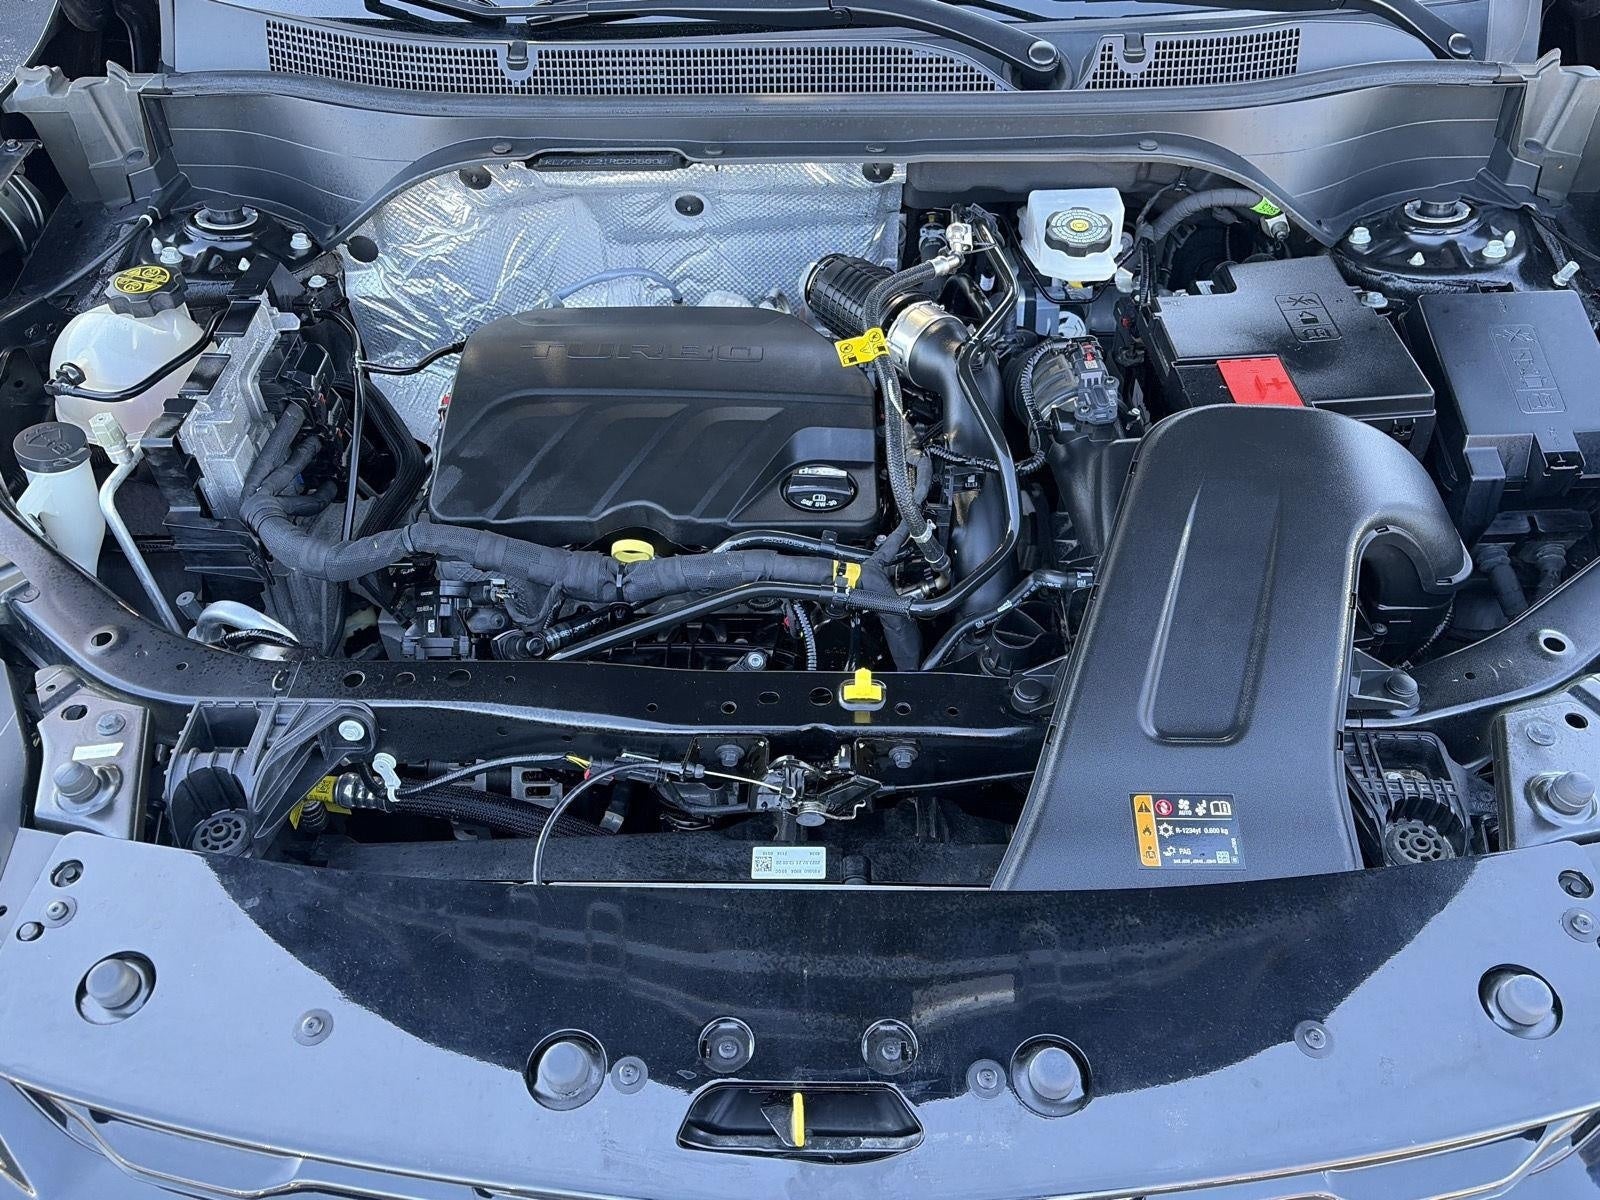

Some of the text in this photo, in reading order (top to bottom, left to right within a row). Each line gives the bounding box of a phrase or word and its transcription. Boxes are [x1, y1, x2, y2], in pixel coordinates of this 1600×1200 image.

[520, 344, 764, 362] TURBO
[1175, 827, 1201, 835] R-1234yf
[1220, 826, 1229, 835] kg
[1179, 847, 1192, 855] PAG
